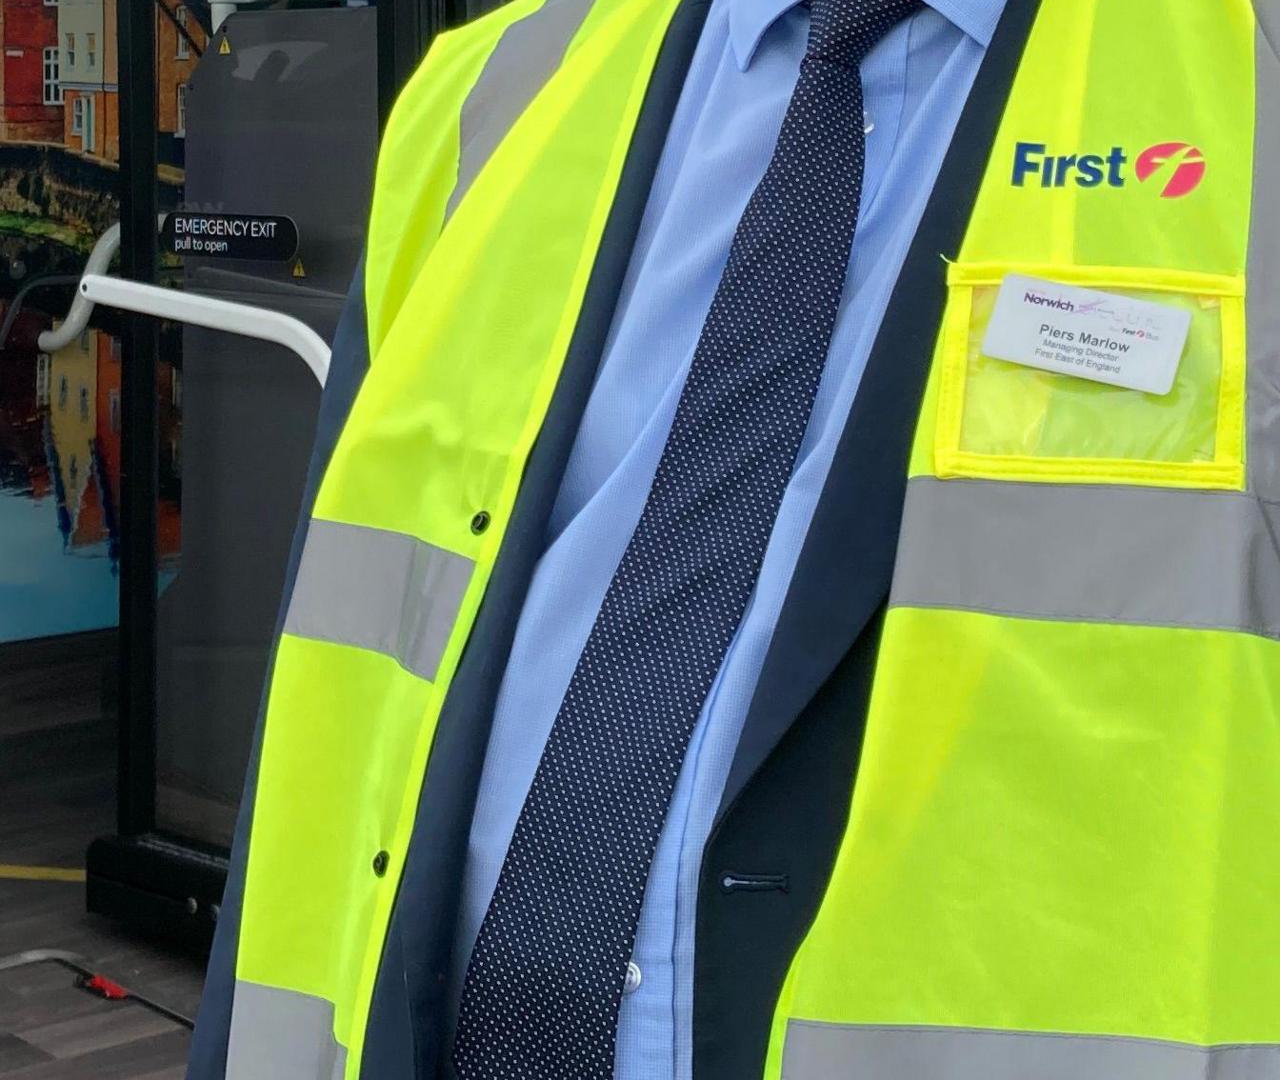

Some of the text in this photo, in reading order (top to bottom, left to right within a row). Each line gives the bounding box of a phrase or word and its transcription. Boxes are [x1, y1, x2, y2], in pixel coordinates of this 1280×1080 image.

[1010, 141, 1128, 188] First
[175, 218, 278, 238] EMERGENCY EXIT
[174, 236, 228, 253] pull to open
[1024, 291, 1074, 312] Norwich
[1039, 324, 1074, 341] Piers
[1078, 331, 1130, 353] Marlow
[1043, 338, 1084, 356] Managing
